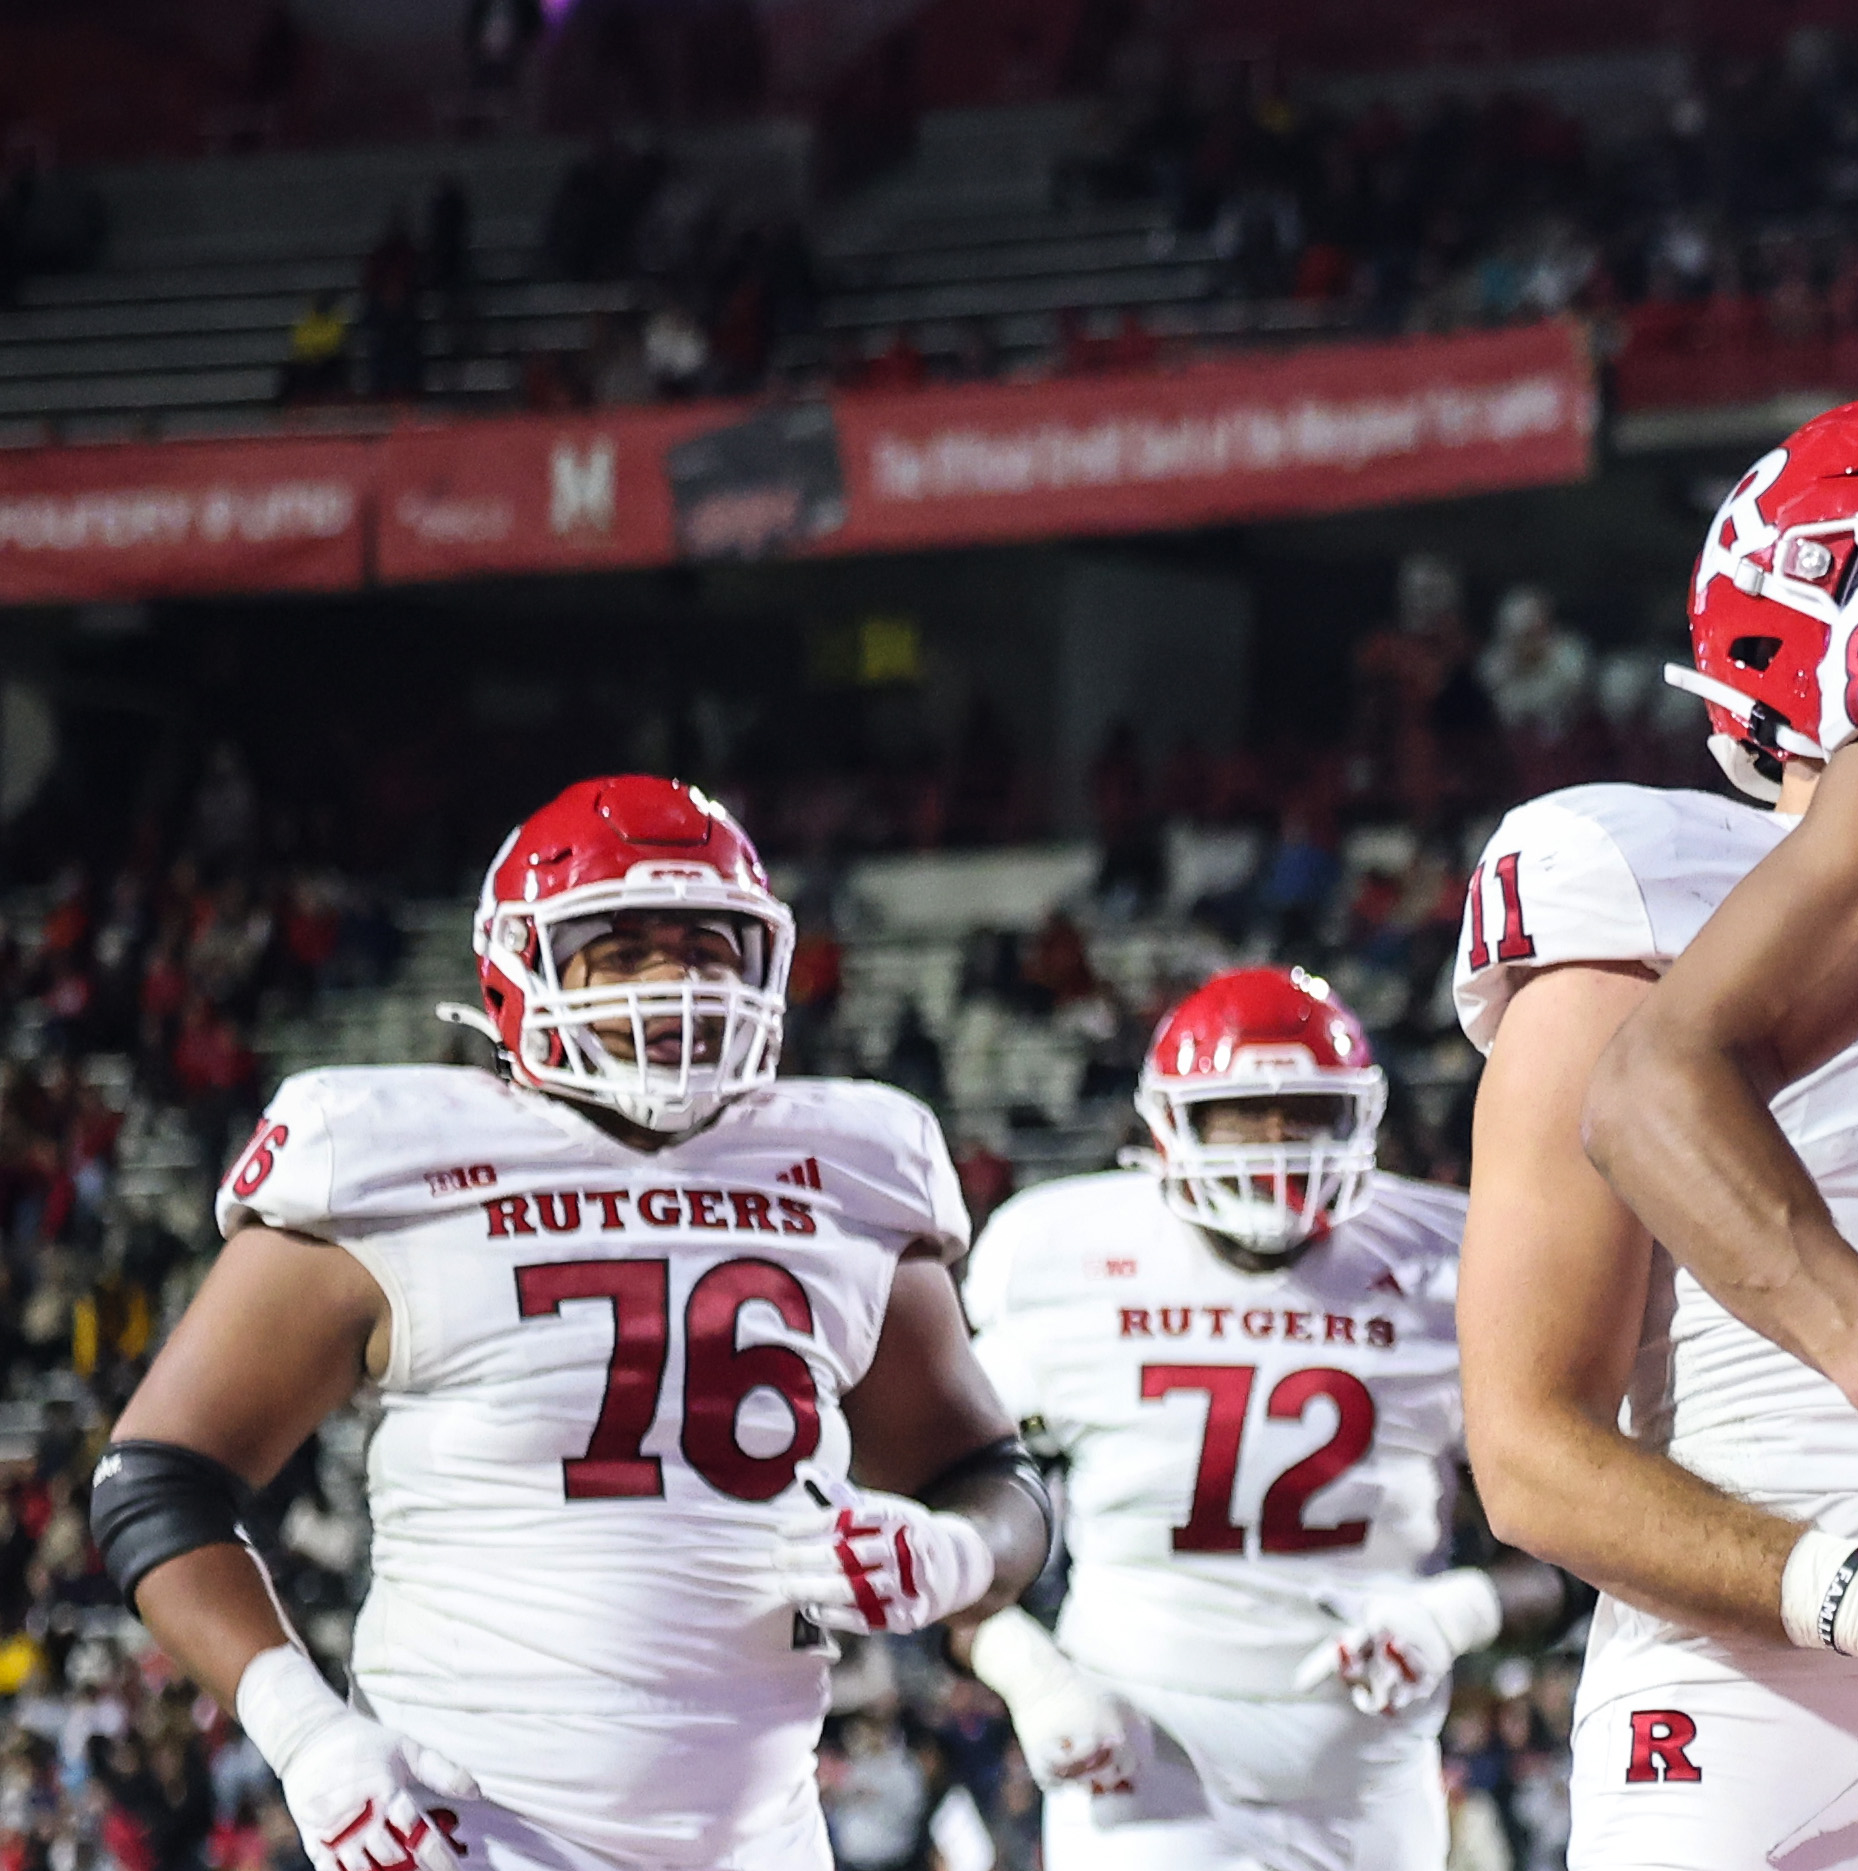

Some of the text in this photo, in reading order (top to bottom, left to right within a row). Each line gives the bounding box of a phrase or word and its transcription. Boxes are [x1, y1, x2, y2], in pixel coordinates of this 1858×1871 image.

[1468, 851, 1537, 974] 11
[481, 1188, 817, 1240] RUTGERS
[1119, 1307, 1395, 1350] RUTGERS
[514, 1257, 821, 1503] 76
[1139, 1363, 1376, 1554] 72
[1625, 1709, 1703, 1783] R
